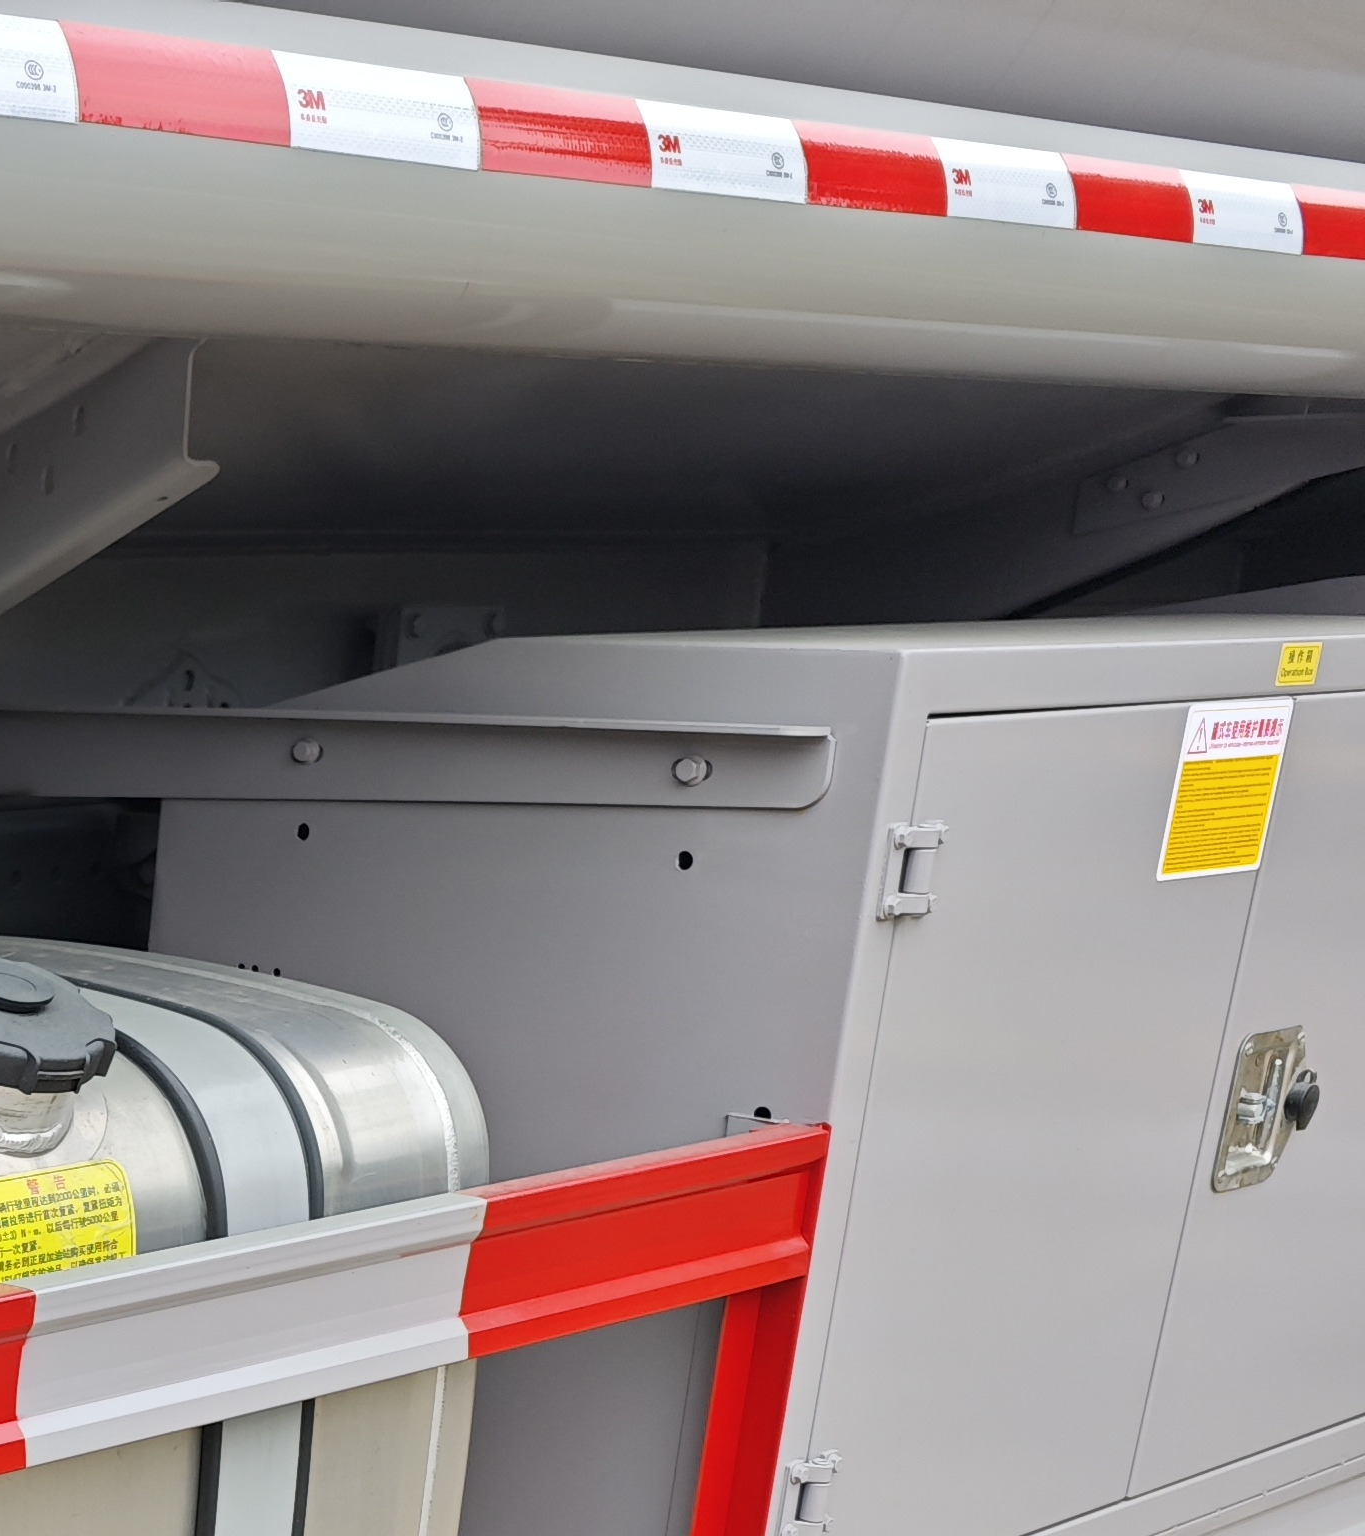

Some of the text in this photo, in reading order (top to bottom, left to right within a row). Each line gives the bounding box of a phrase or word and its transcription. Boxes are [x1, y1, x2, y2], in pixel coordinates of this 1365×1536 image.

[298, 88, 326, 111] 3M
[657, 133, 681, 154] 3M
[951, 167, 972, 187] 3M
[1197, 198, 1215, 216] 3M
